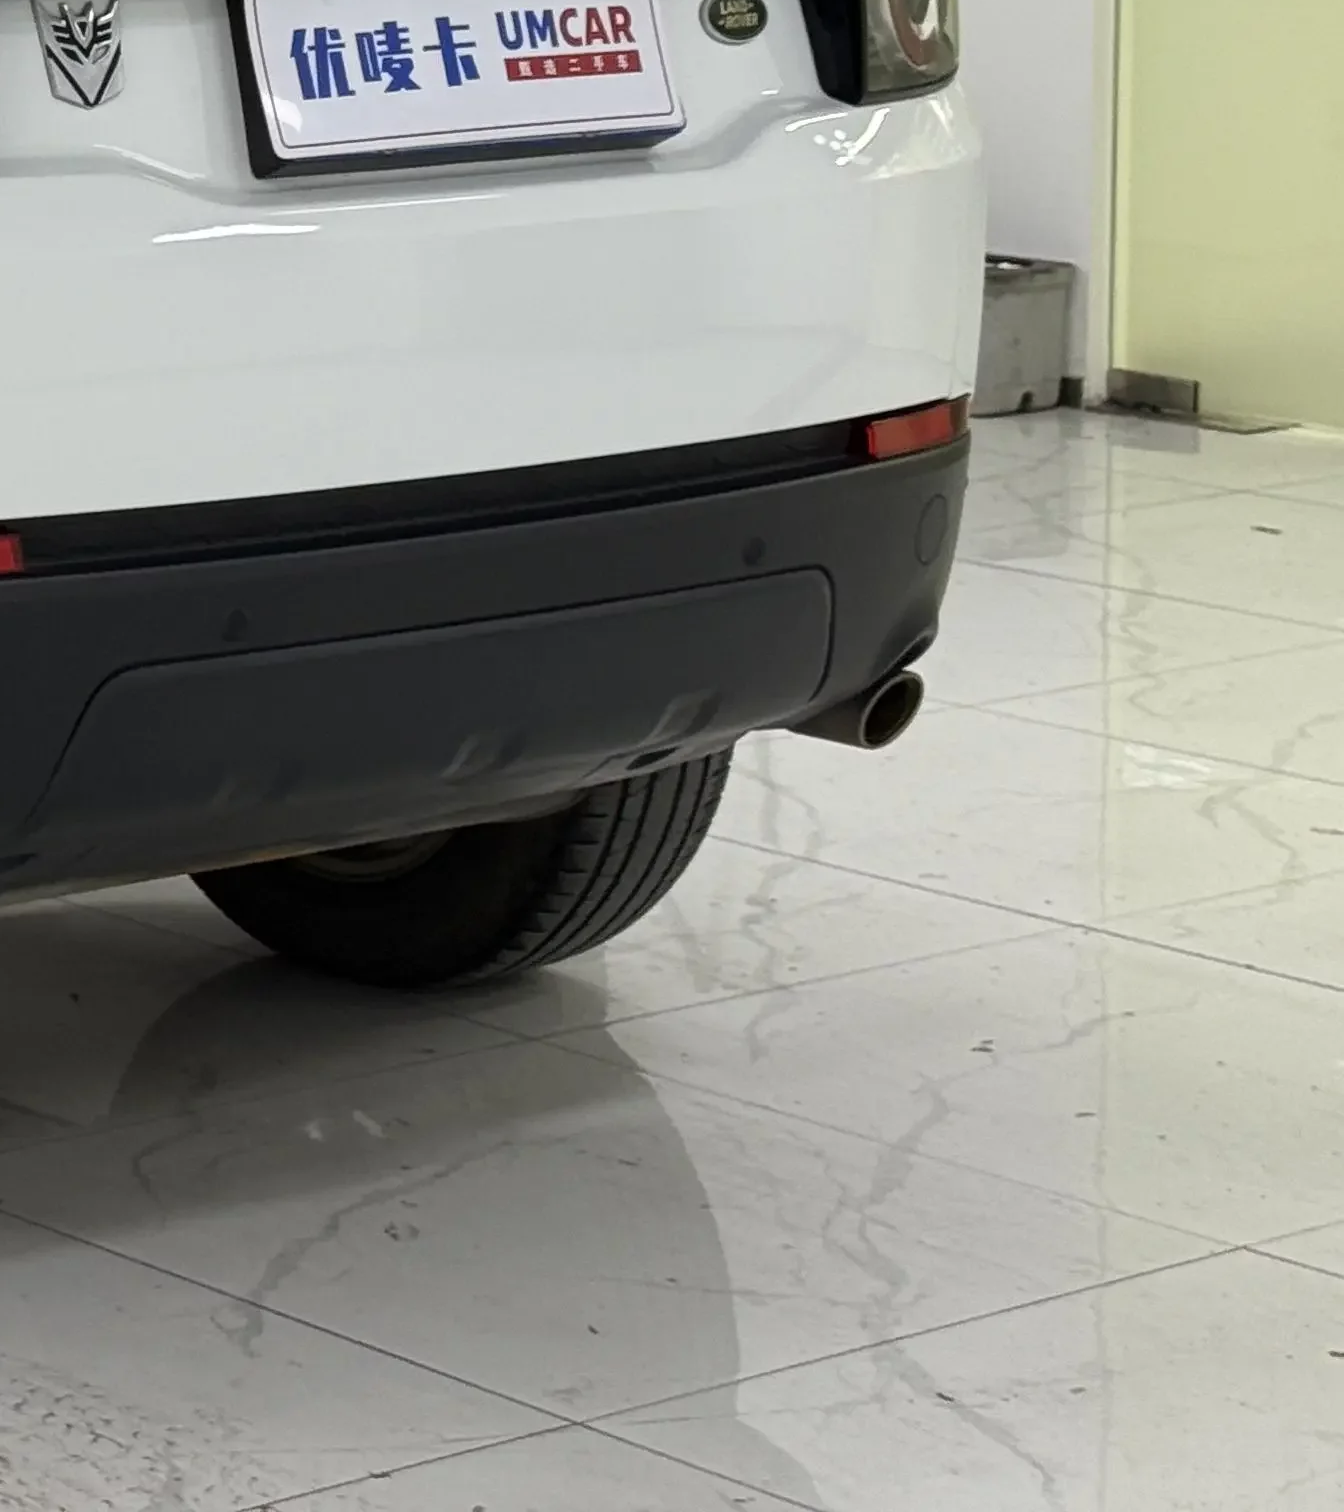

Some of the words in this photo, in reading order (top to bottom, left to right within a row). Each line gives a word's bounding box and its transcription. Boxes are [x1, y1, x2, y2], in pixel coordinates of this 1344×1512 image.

[289, 16, 481, 101] 优唛卡
[495, 5, 636, 50] UMCAR
